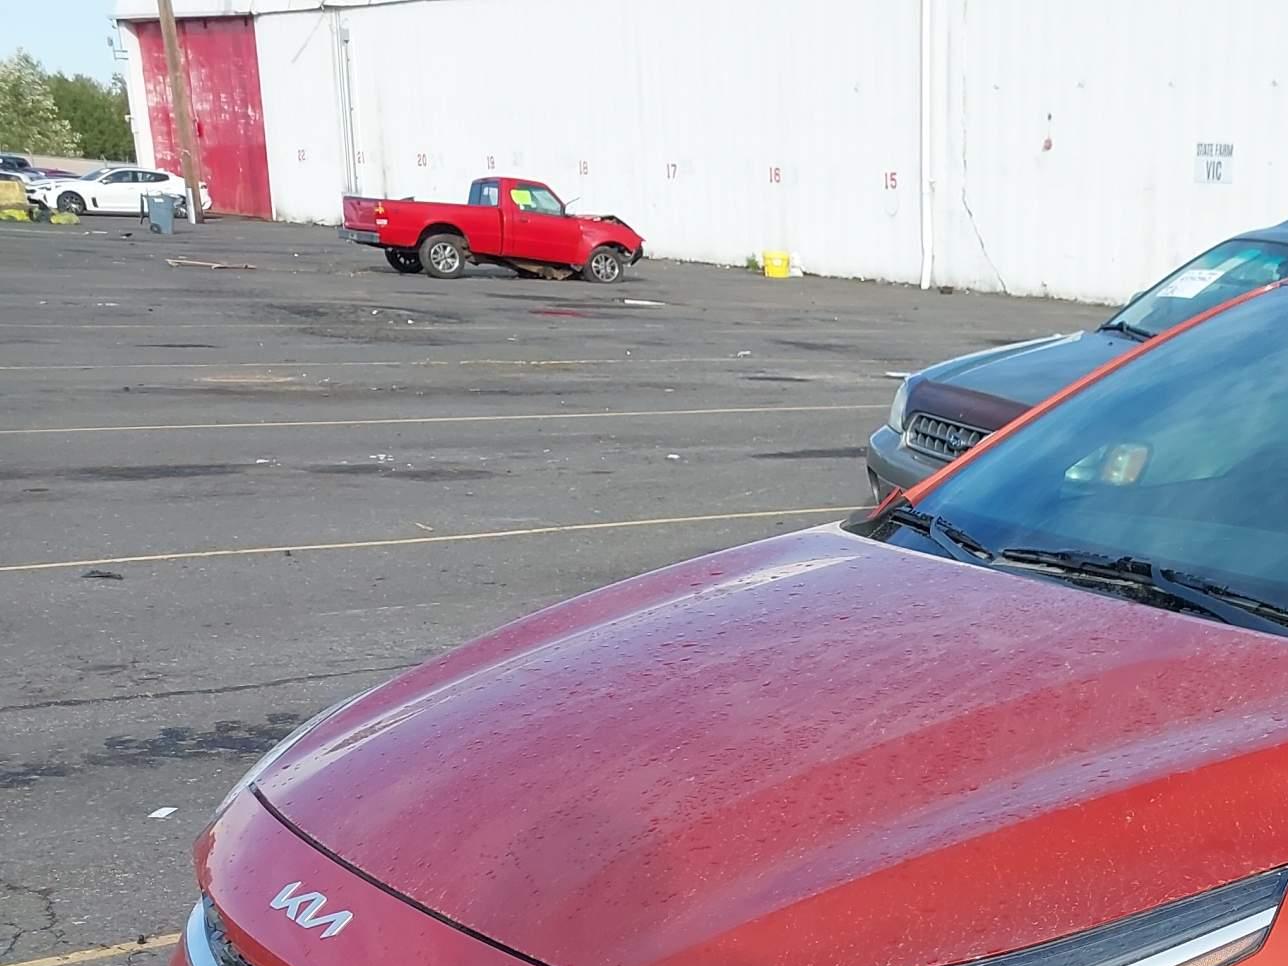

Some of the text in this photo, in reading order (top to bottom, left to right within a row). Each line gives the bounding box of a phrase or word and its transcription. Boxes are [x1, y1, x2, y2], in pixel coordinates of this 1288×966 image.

[1196, 143, 1234, 157] STATE FARM
[416, 153, 427, 167] 20
[486, 155, 496, 170] 19
[578, 160, 589, 176] 18
[666, 164, 678, 180] 17
[768, 167, 782, 184] 16
[1205, 160, 1223, 181] VIC
[884, 172, 897, 189] 15
[269, 880, 354, 939] KIA
